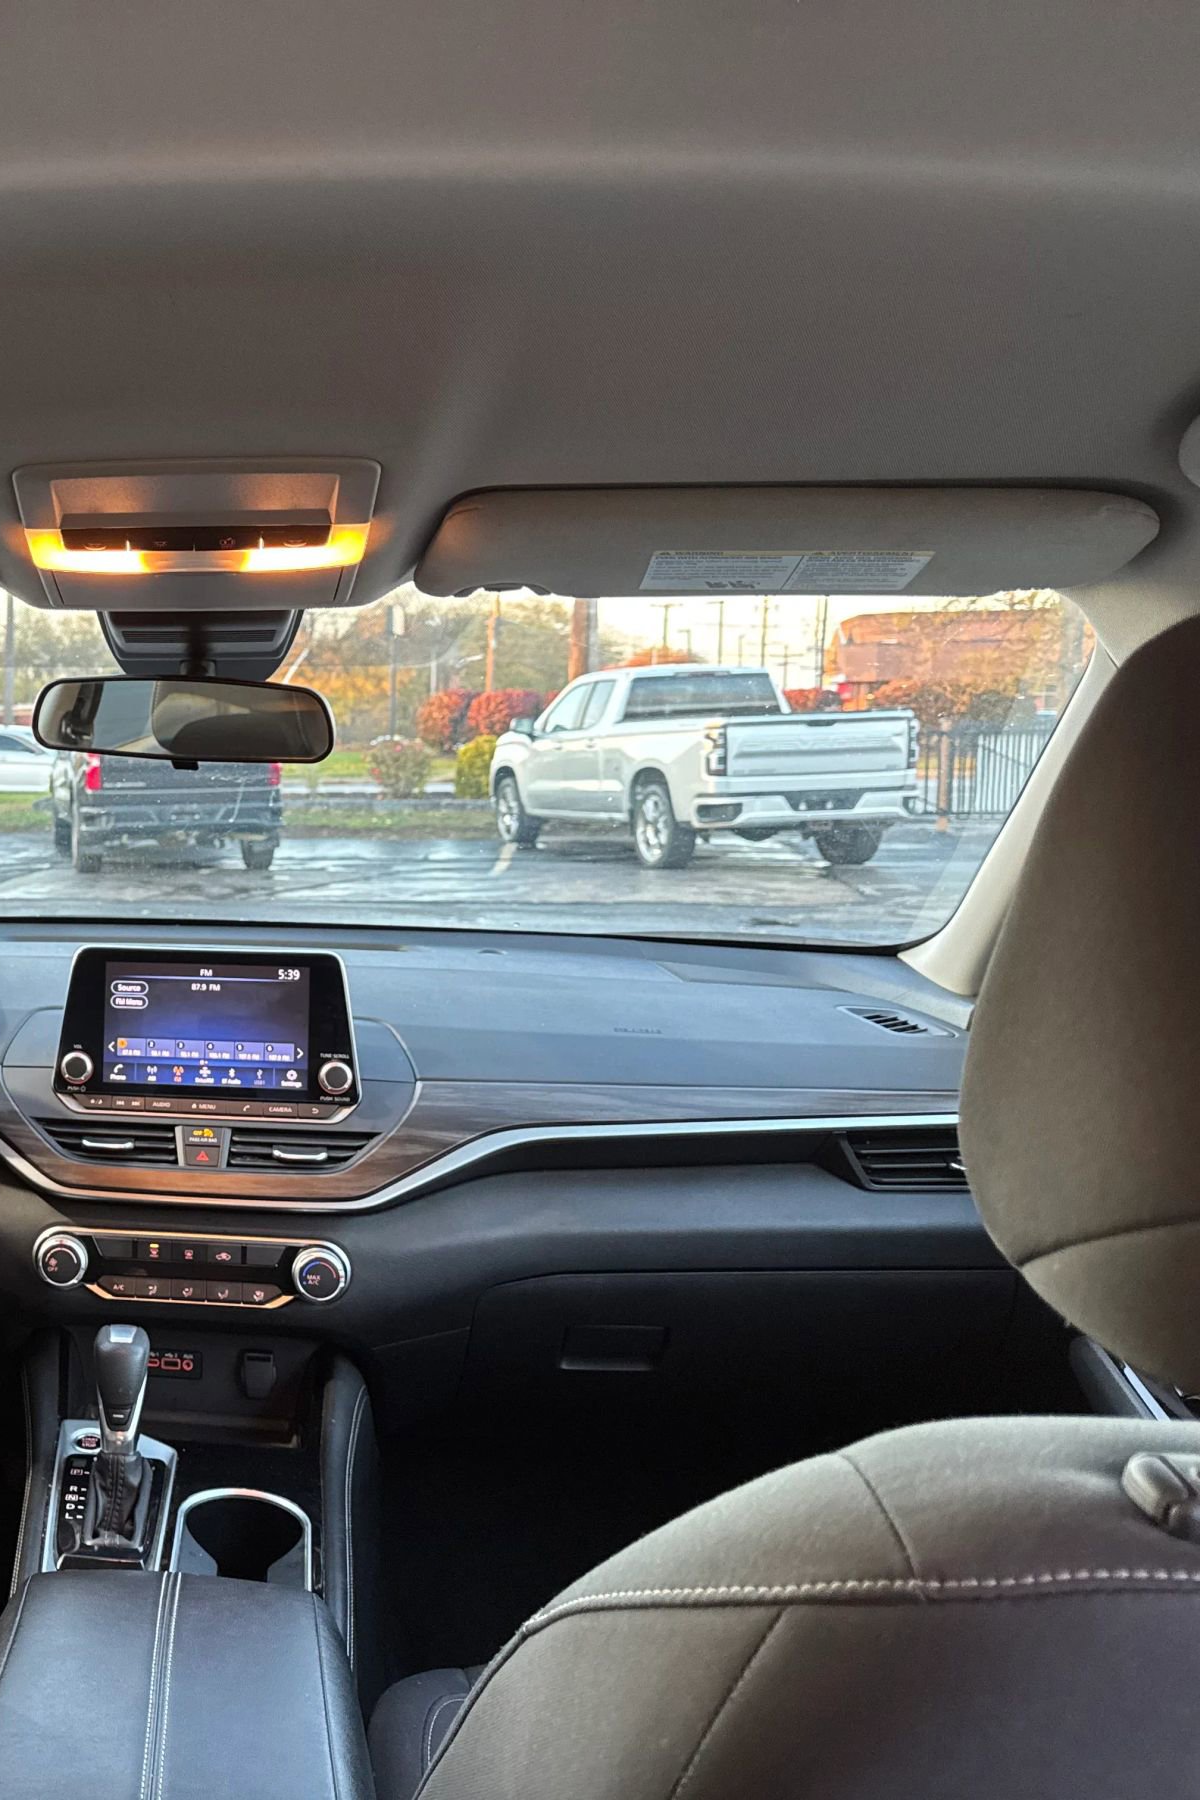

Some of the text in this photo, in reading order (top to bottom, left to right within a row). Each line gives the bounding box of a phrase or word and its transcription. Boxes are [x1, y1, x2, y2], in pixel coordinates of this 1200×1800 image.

[200, 968, 213, 976] FM
[278, 968, 301, 980] 5:39
[117, 984, 142, 992] Source
[191, 983, 207, 991] 87.9
[126, 998, 143, 1006] Menu
